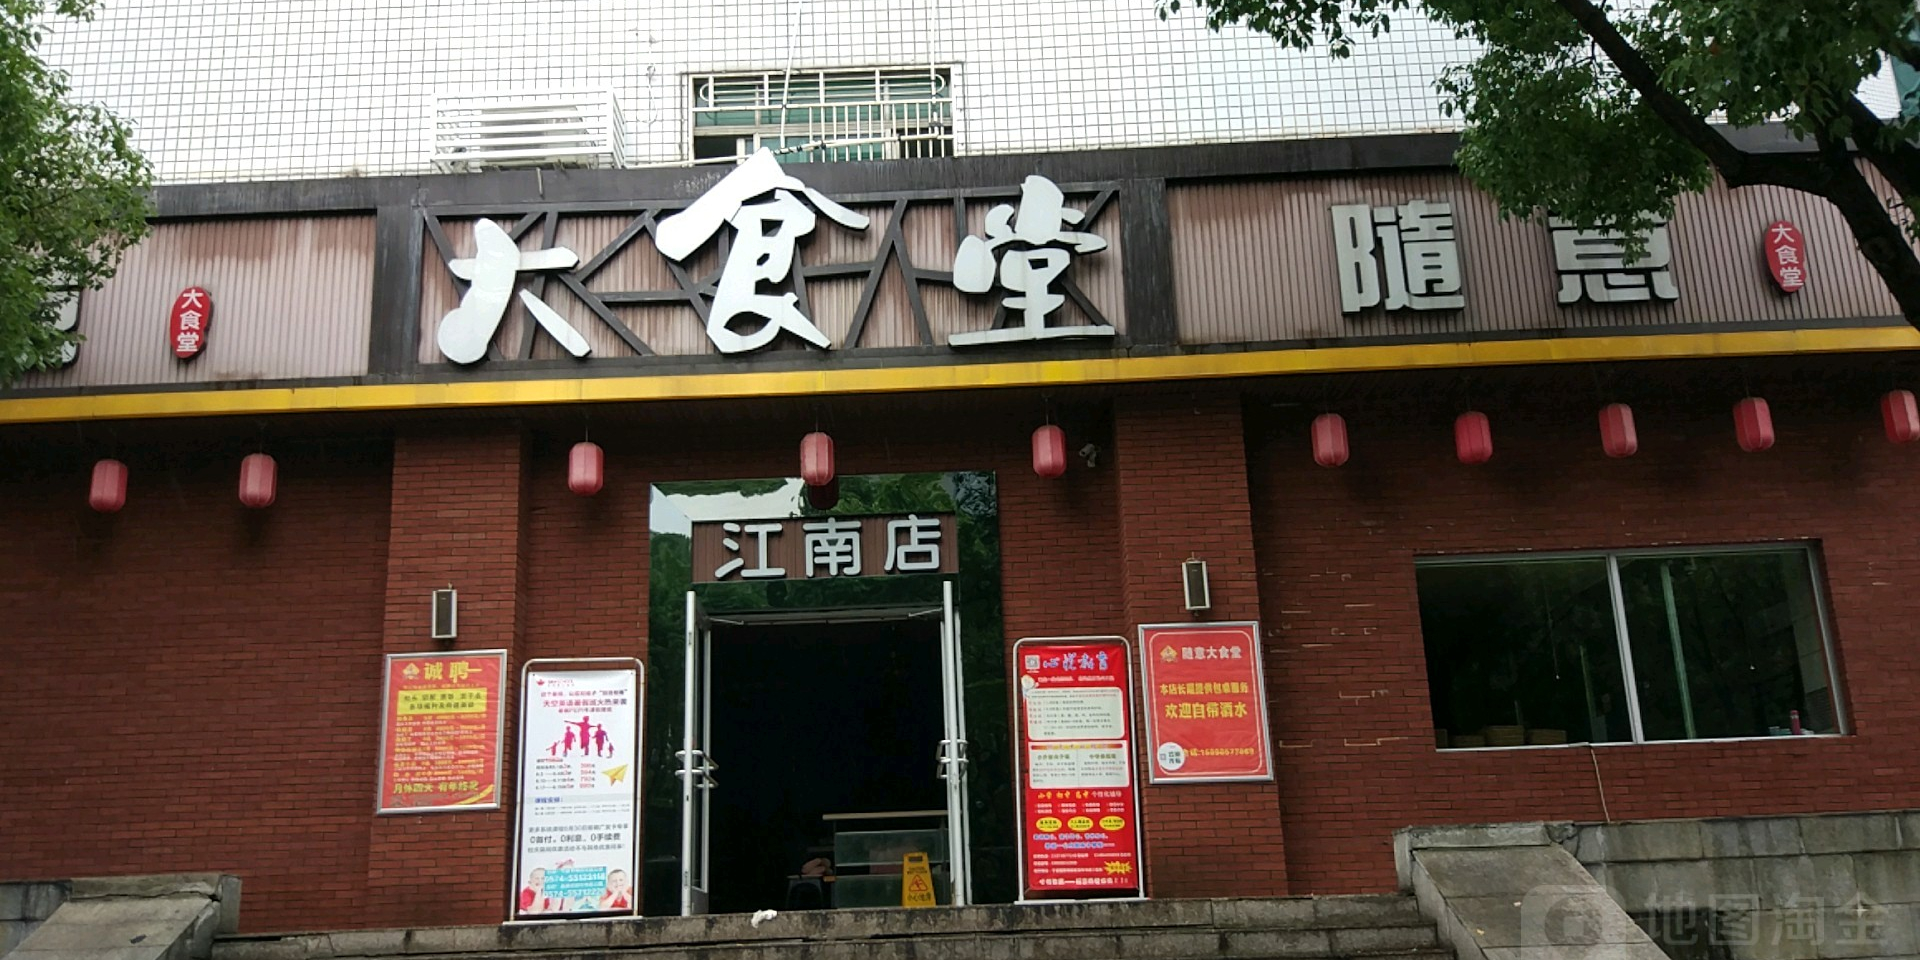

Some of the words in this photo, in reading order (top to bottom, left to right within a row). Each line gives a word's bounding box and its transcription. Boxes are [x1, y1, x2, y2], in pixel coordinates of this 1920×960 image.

[437, 147, 1115, 364] 大食堂
[1772, 224, 1804, 287] 大食堂
[176, 289, 204, 352] 大食堂
[715, 514, 941, 579] 江南店
[1165, 701, 1248, 719] 欢迎自带酒水
